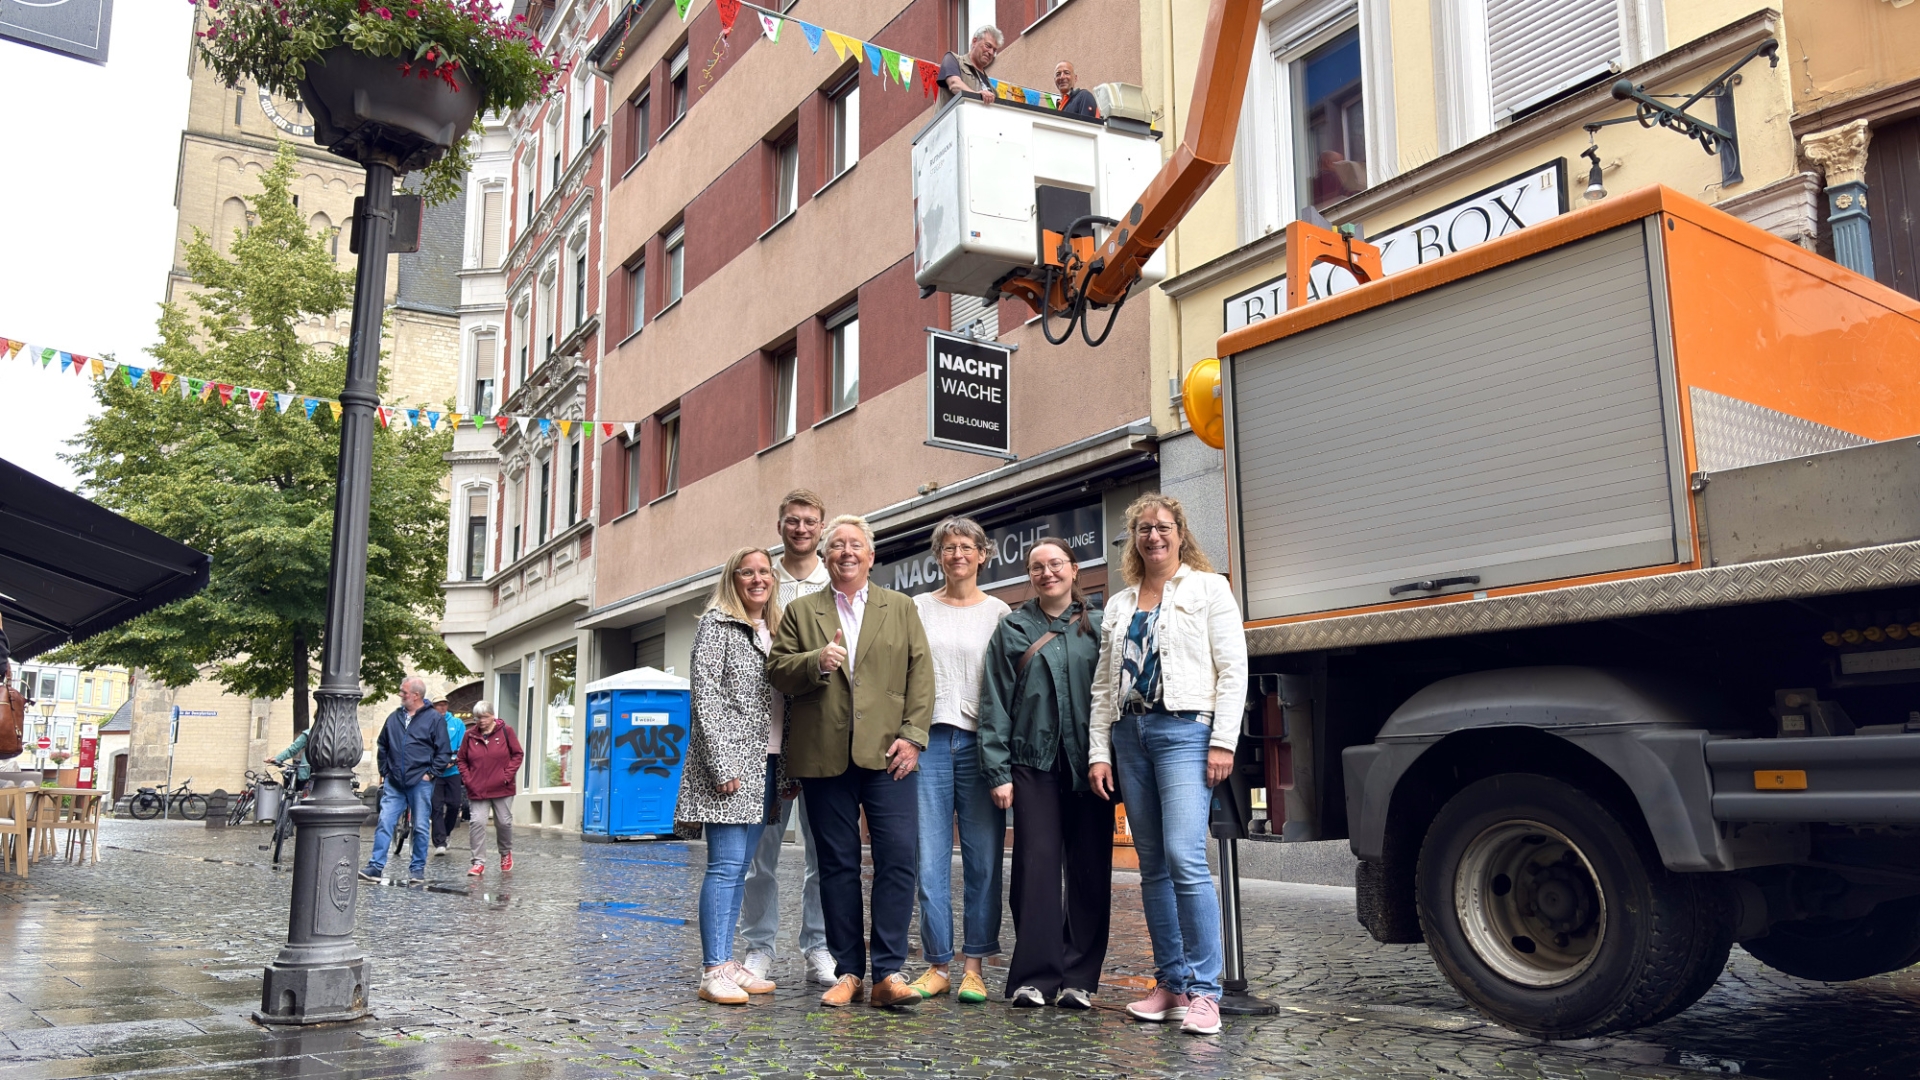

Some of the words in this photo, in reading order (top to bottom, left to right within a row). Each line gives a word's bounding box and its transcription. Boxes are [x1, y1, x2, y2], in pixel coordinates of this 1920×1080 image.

[1411, 184, 1530, 265] BOX
[939, 352, 1003, 380] NACHT
[940, 376, 1002, 404] WACHE
[943, 413, 1000, 431] CLUB-LOUNGE
[1117, 816, 1125, 834] SAYS
